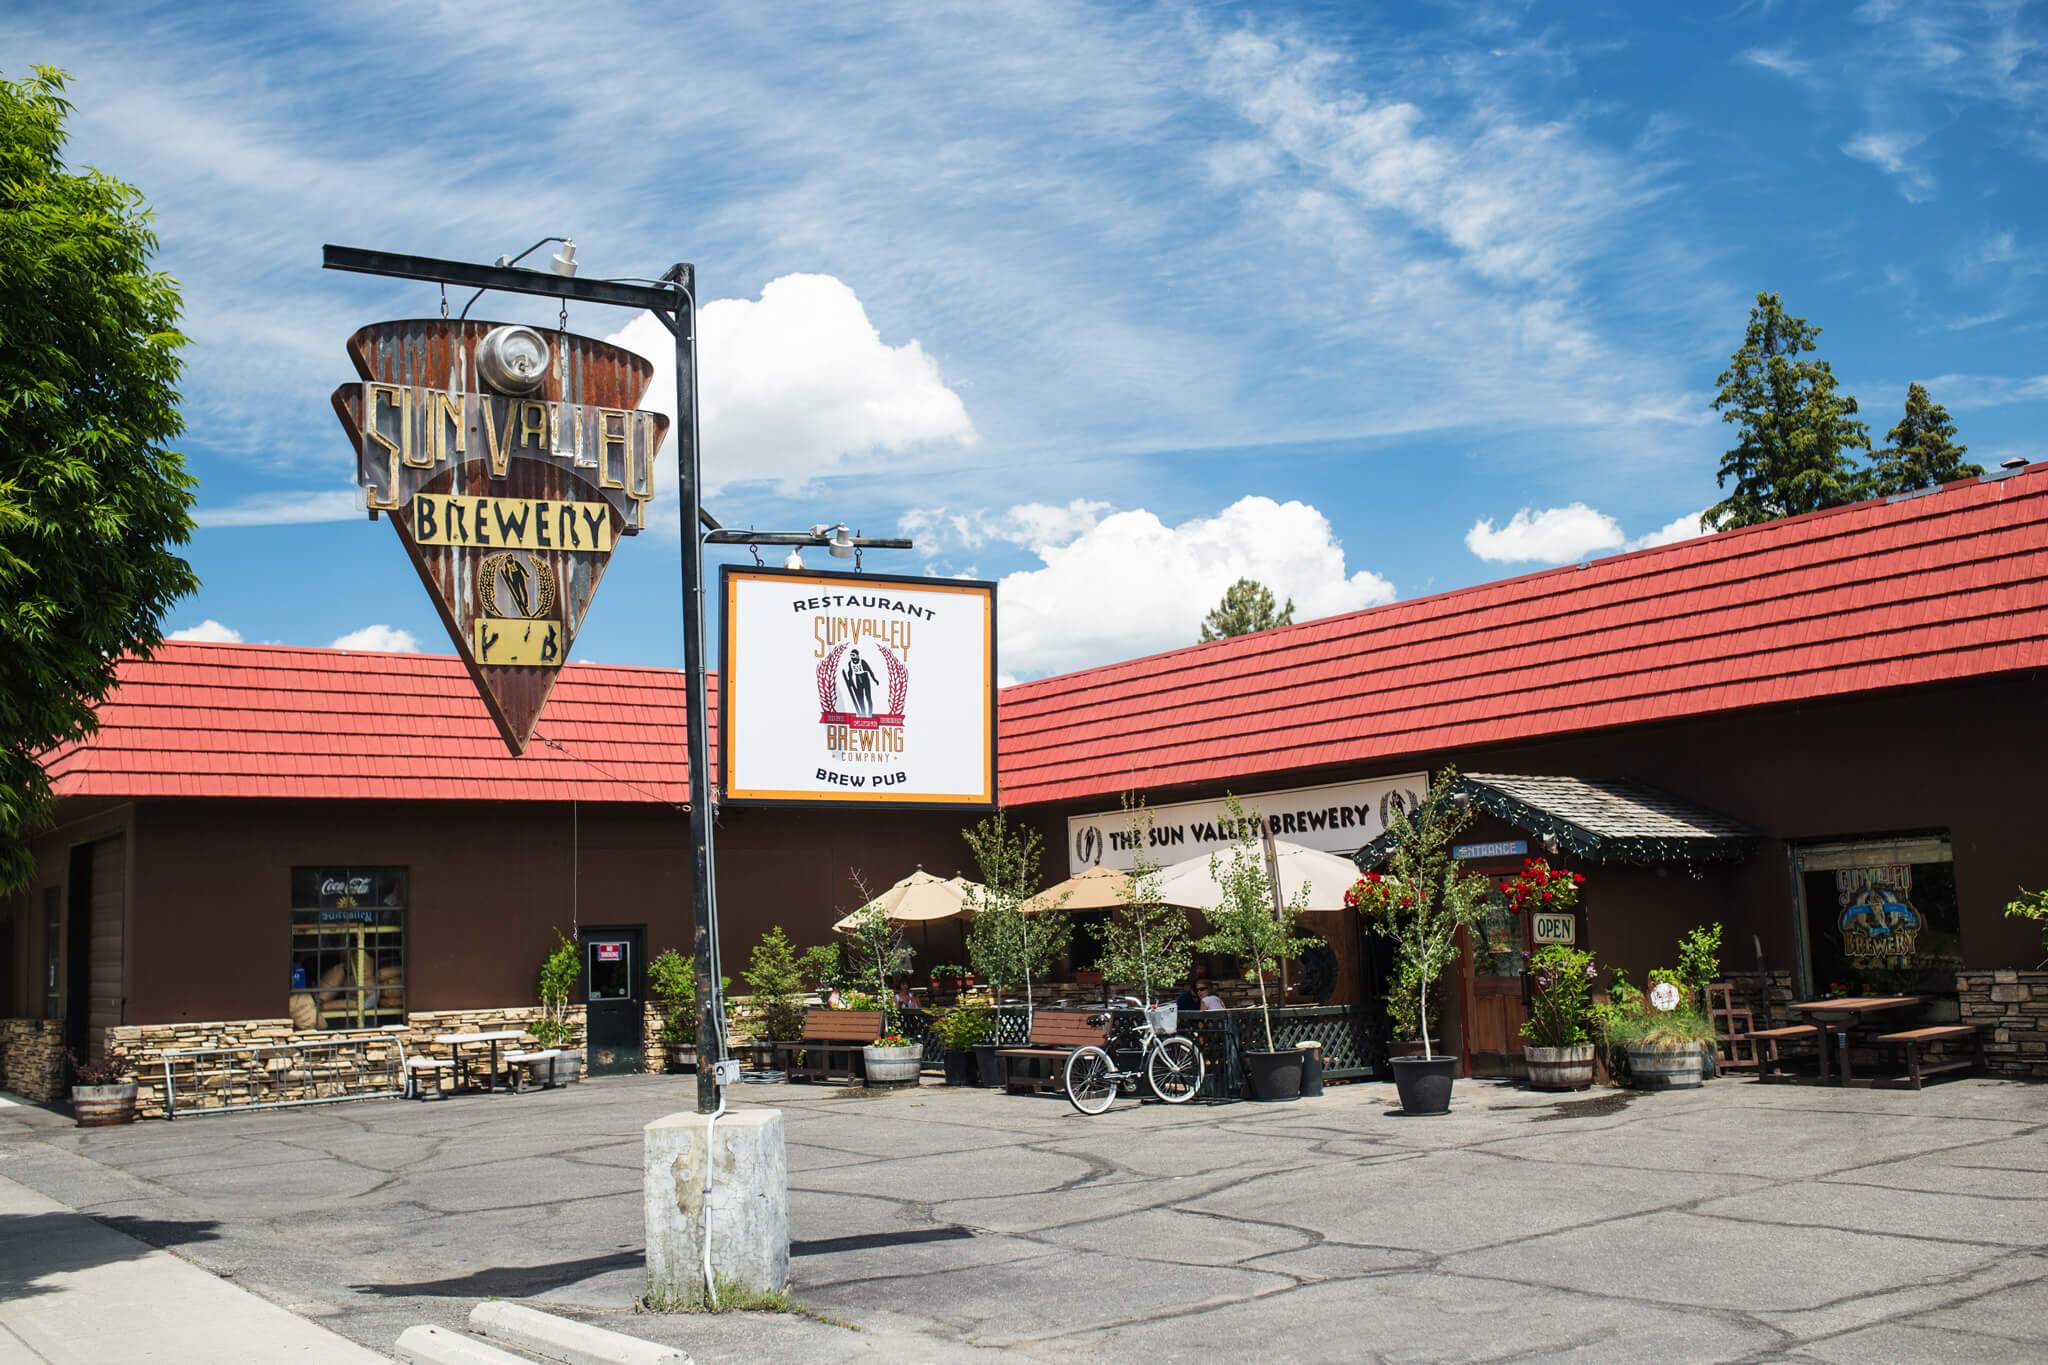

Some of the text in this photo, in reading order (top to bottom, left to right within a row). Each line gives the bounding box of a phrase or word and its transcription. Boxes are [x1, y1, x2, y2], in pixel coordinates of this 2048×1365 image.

[416, 497, 607, 549] BREWERY
[793, 595, 936, 621] RESTAURANT
[482, 622, 557, 662] PB
[827, 725, 904, 752] BREWING
[841, 751, 890, 762] COMPANY
[816, 768, 907, 787] BREW PUB
[1109, 830, 1143, 851] THE
[1150, 825, 1184, 847] SUN
[1270, 804, 1370, 835] BREWERY
[1459, 842, 1516, 857] NTRANCE
[321, 877, 371, 895] CocaCola
[1537, 918, 1571, 939] OPEN
